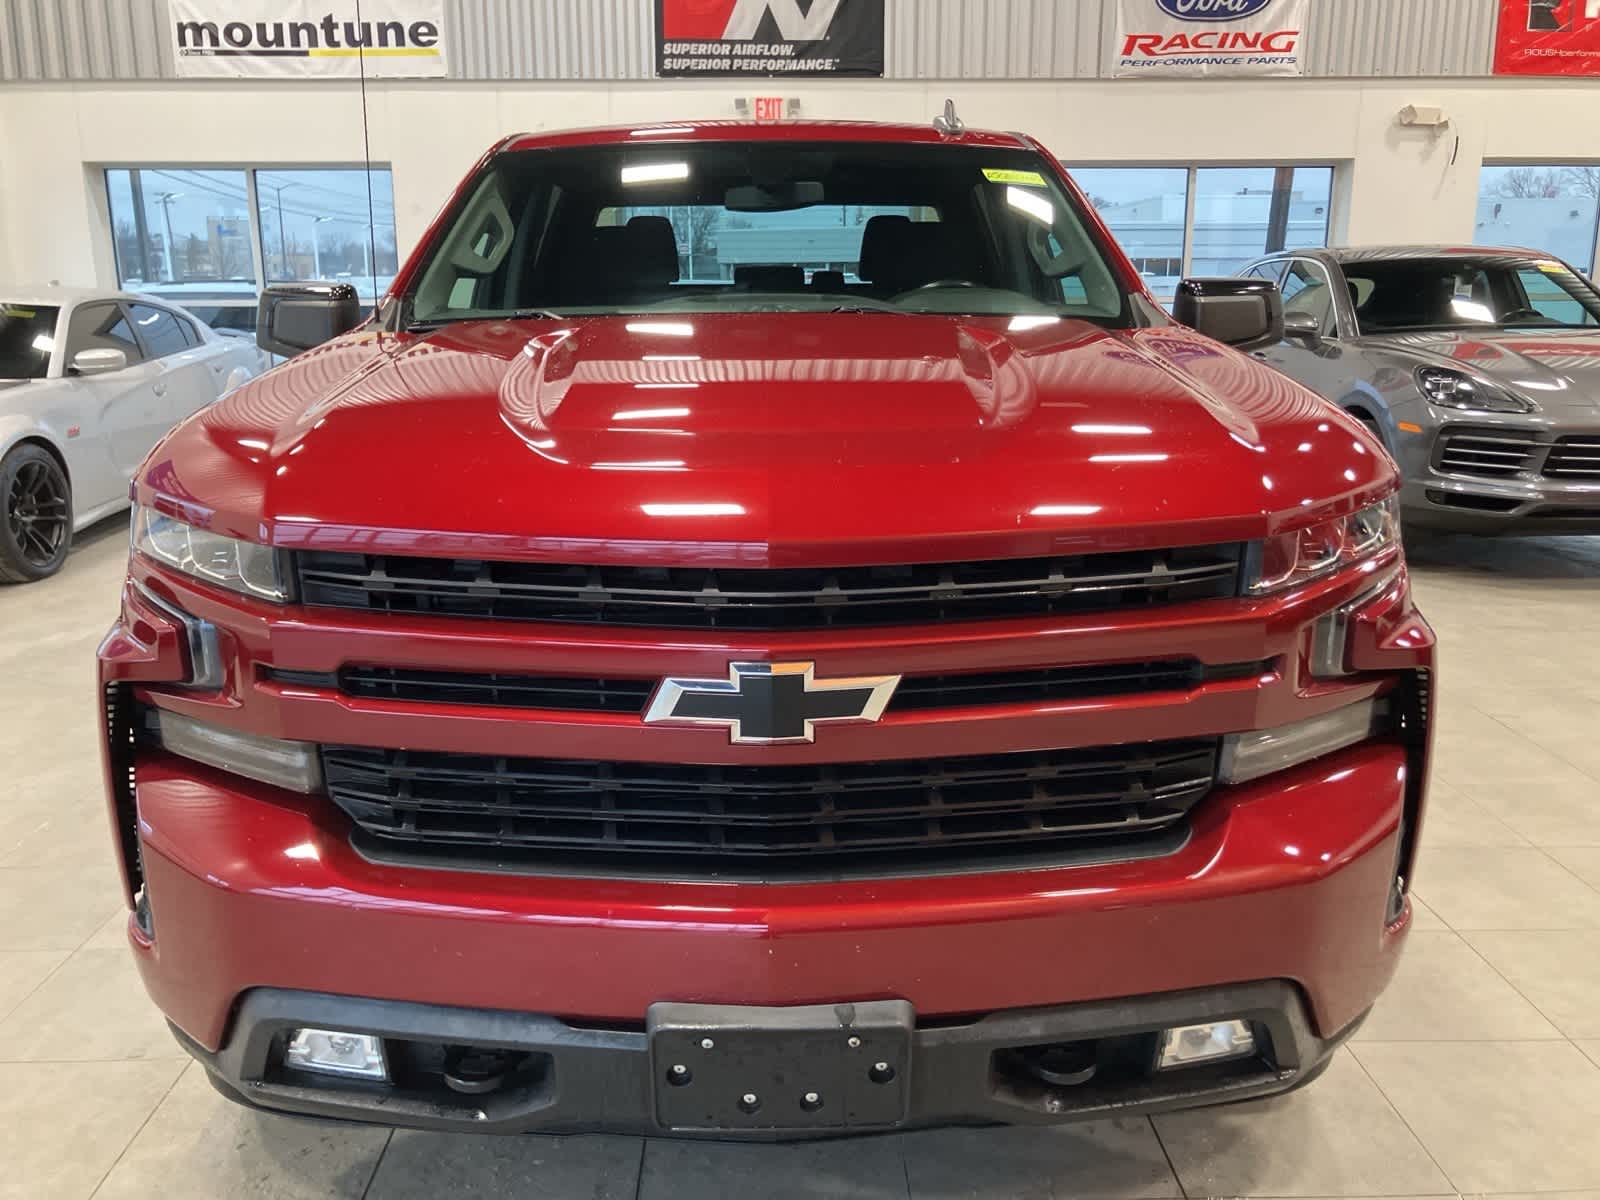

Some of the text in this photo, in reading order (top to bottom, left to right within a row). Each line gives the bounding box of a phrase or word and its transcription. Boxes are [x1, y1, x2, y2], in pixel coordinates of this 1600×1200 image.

[176, 12, 439, 48] mountune
[663, 43, 796, 56] SUPERIOR AIRFLOW.
[1121, 31, 1300, 56] RACING
[663, 58, 730, 70] SUPERIOR
[1120, 57, 1297, 67] PERFORMANCE PARTS
[755, 97, 784, 120] EXIT
